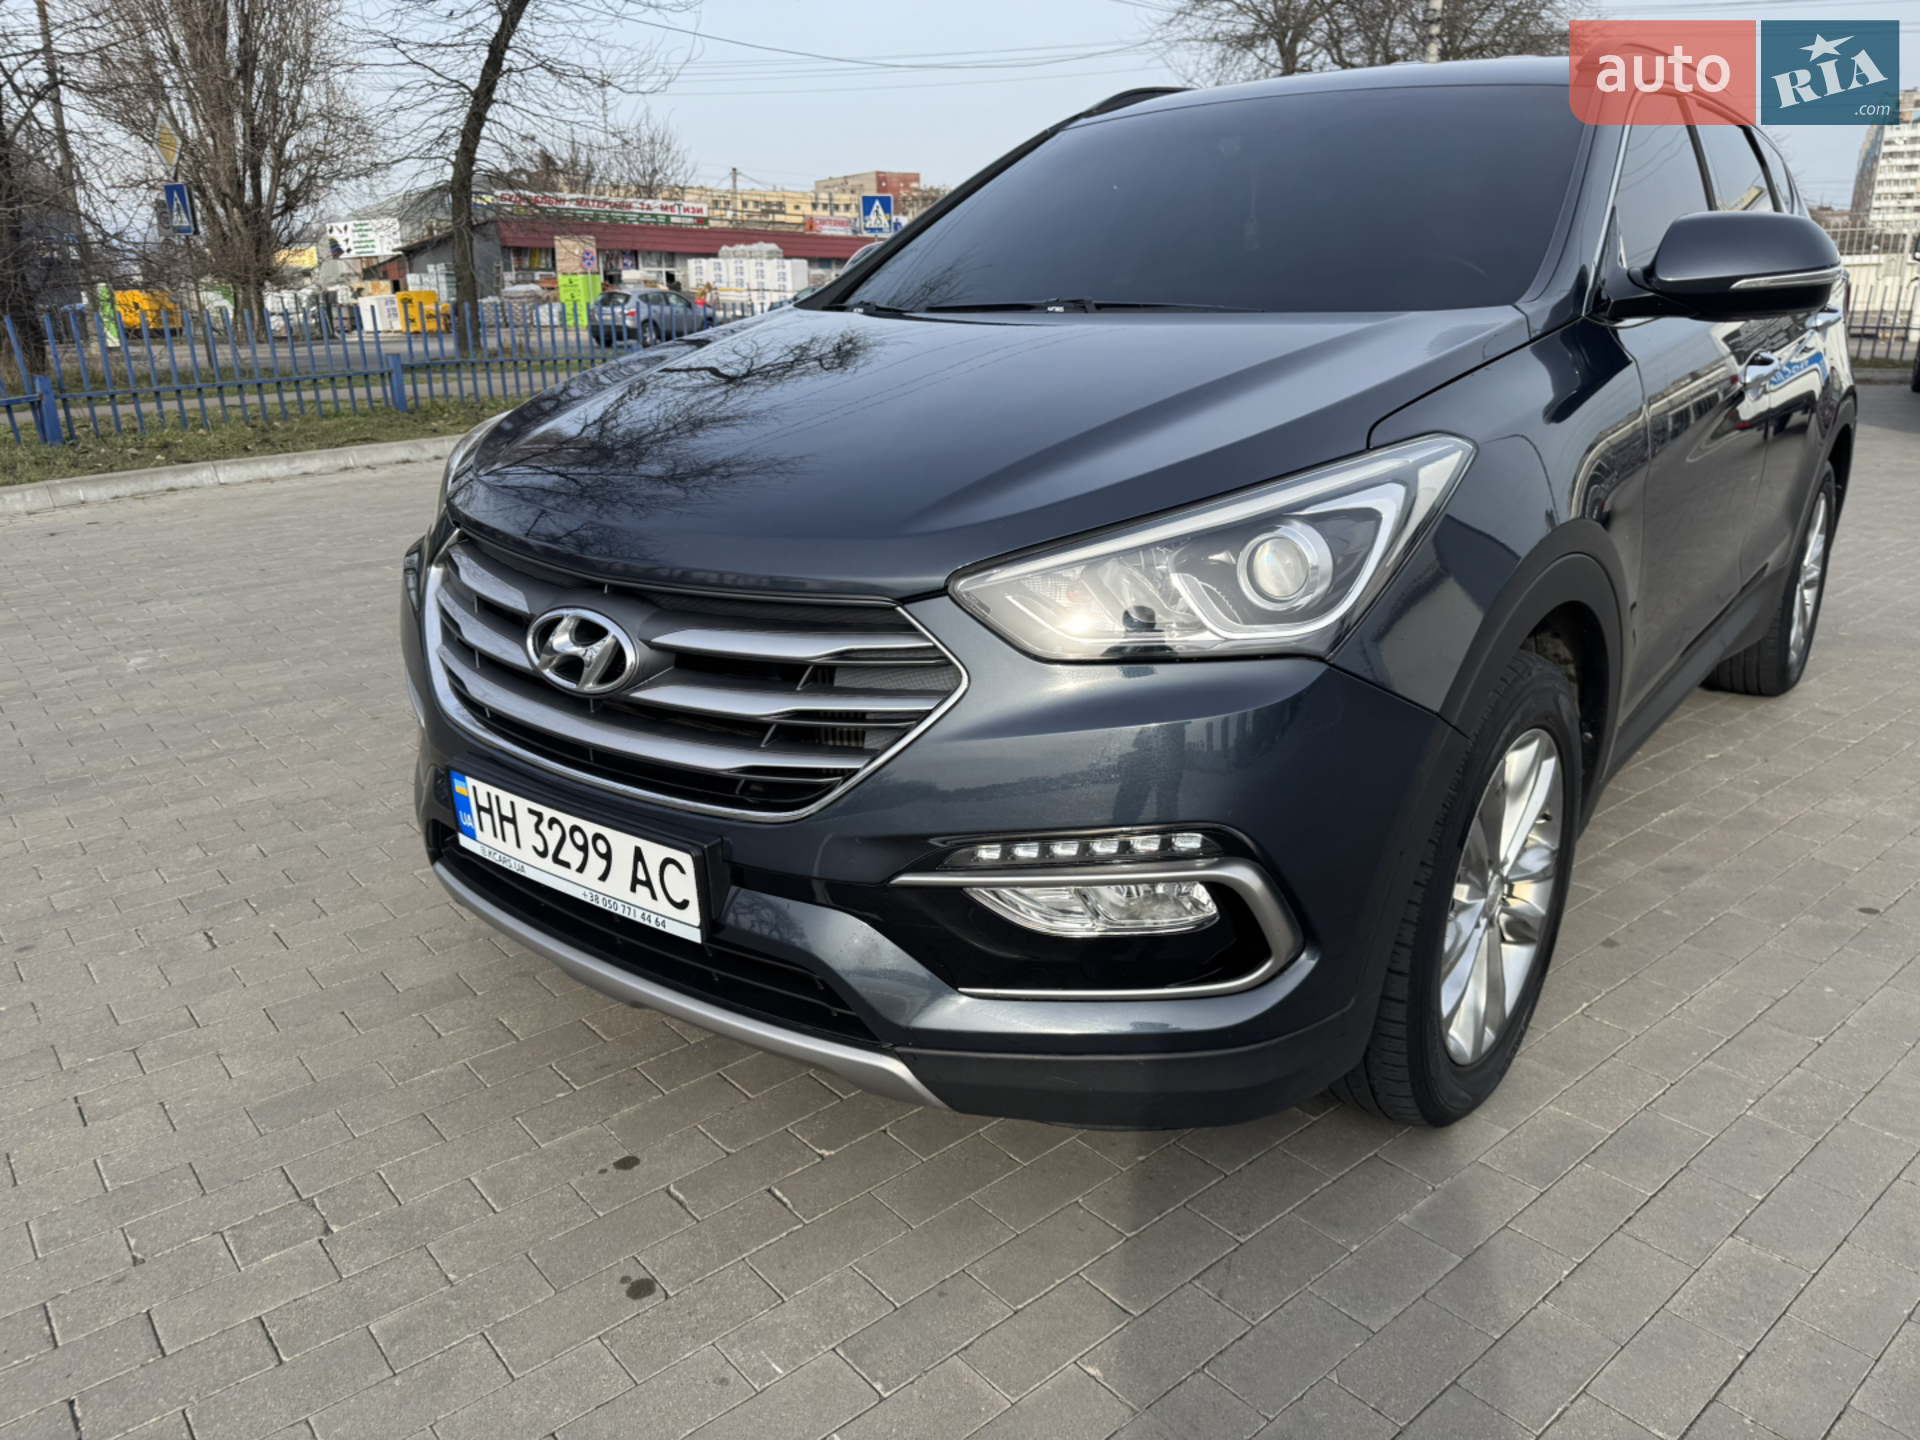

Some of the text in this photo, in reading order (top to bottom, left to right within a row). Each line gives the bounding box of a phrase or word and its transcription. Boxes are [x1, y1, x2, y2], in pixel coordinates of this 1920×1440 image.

[459, 810, 475, 829] UA
[472, 785, 690, 911] HH 3299 AC
[582, 891, 600, 905] +38
[602, 897, 618, 912] 050
[621, 904, 637, 918] 771
